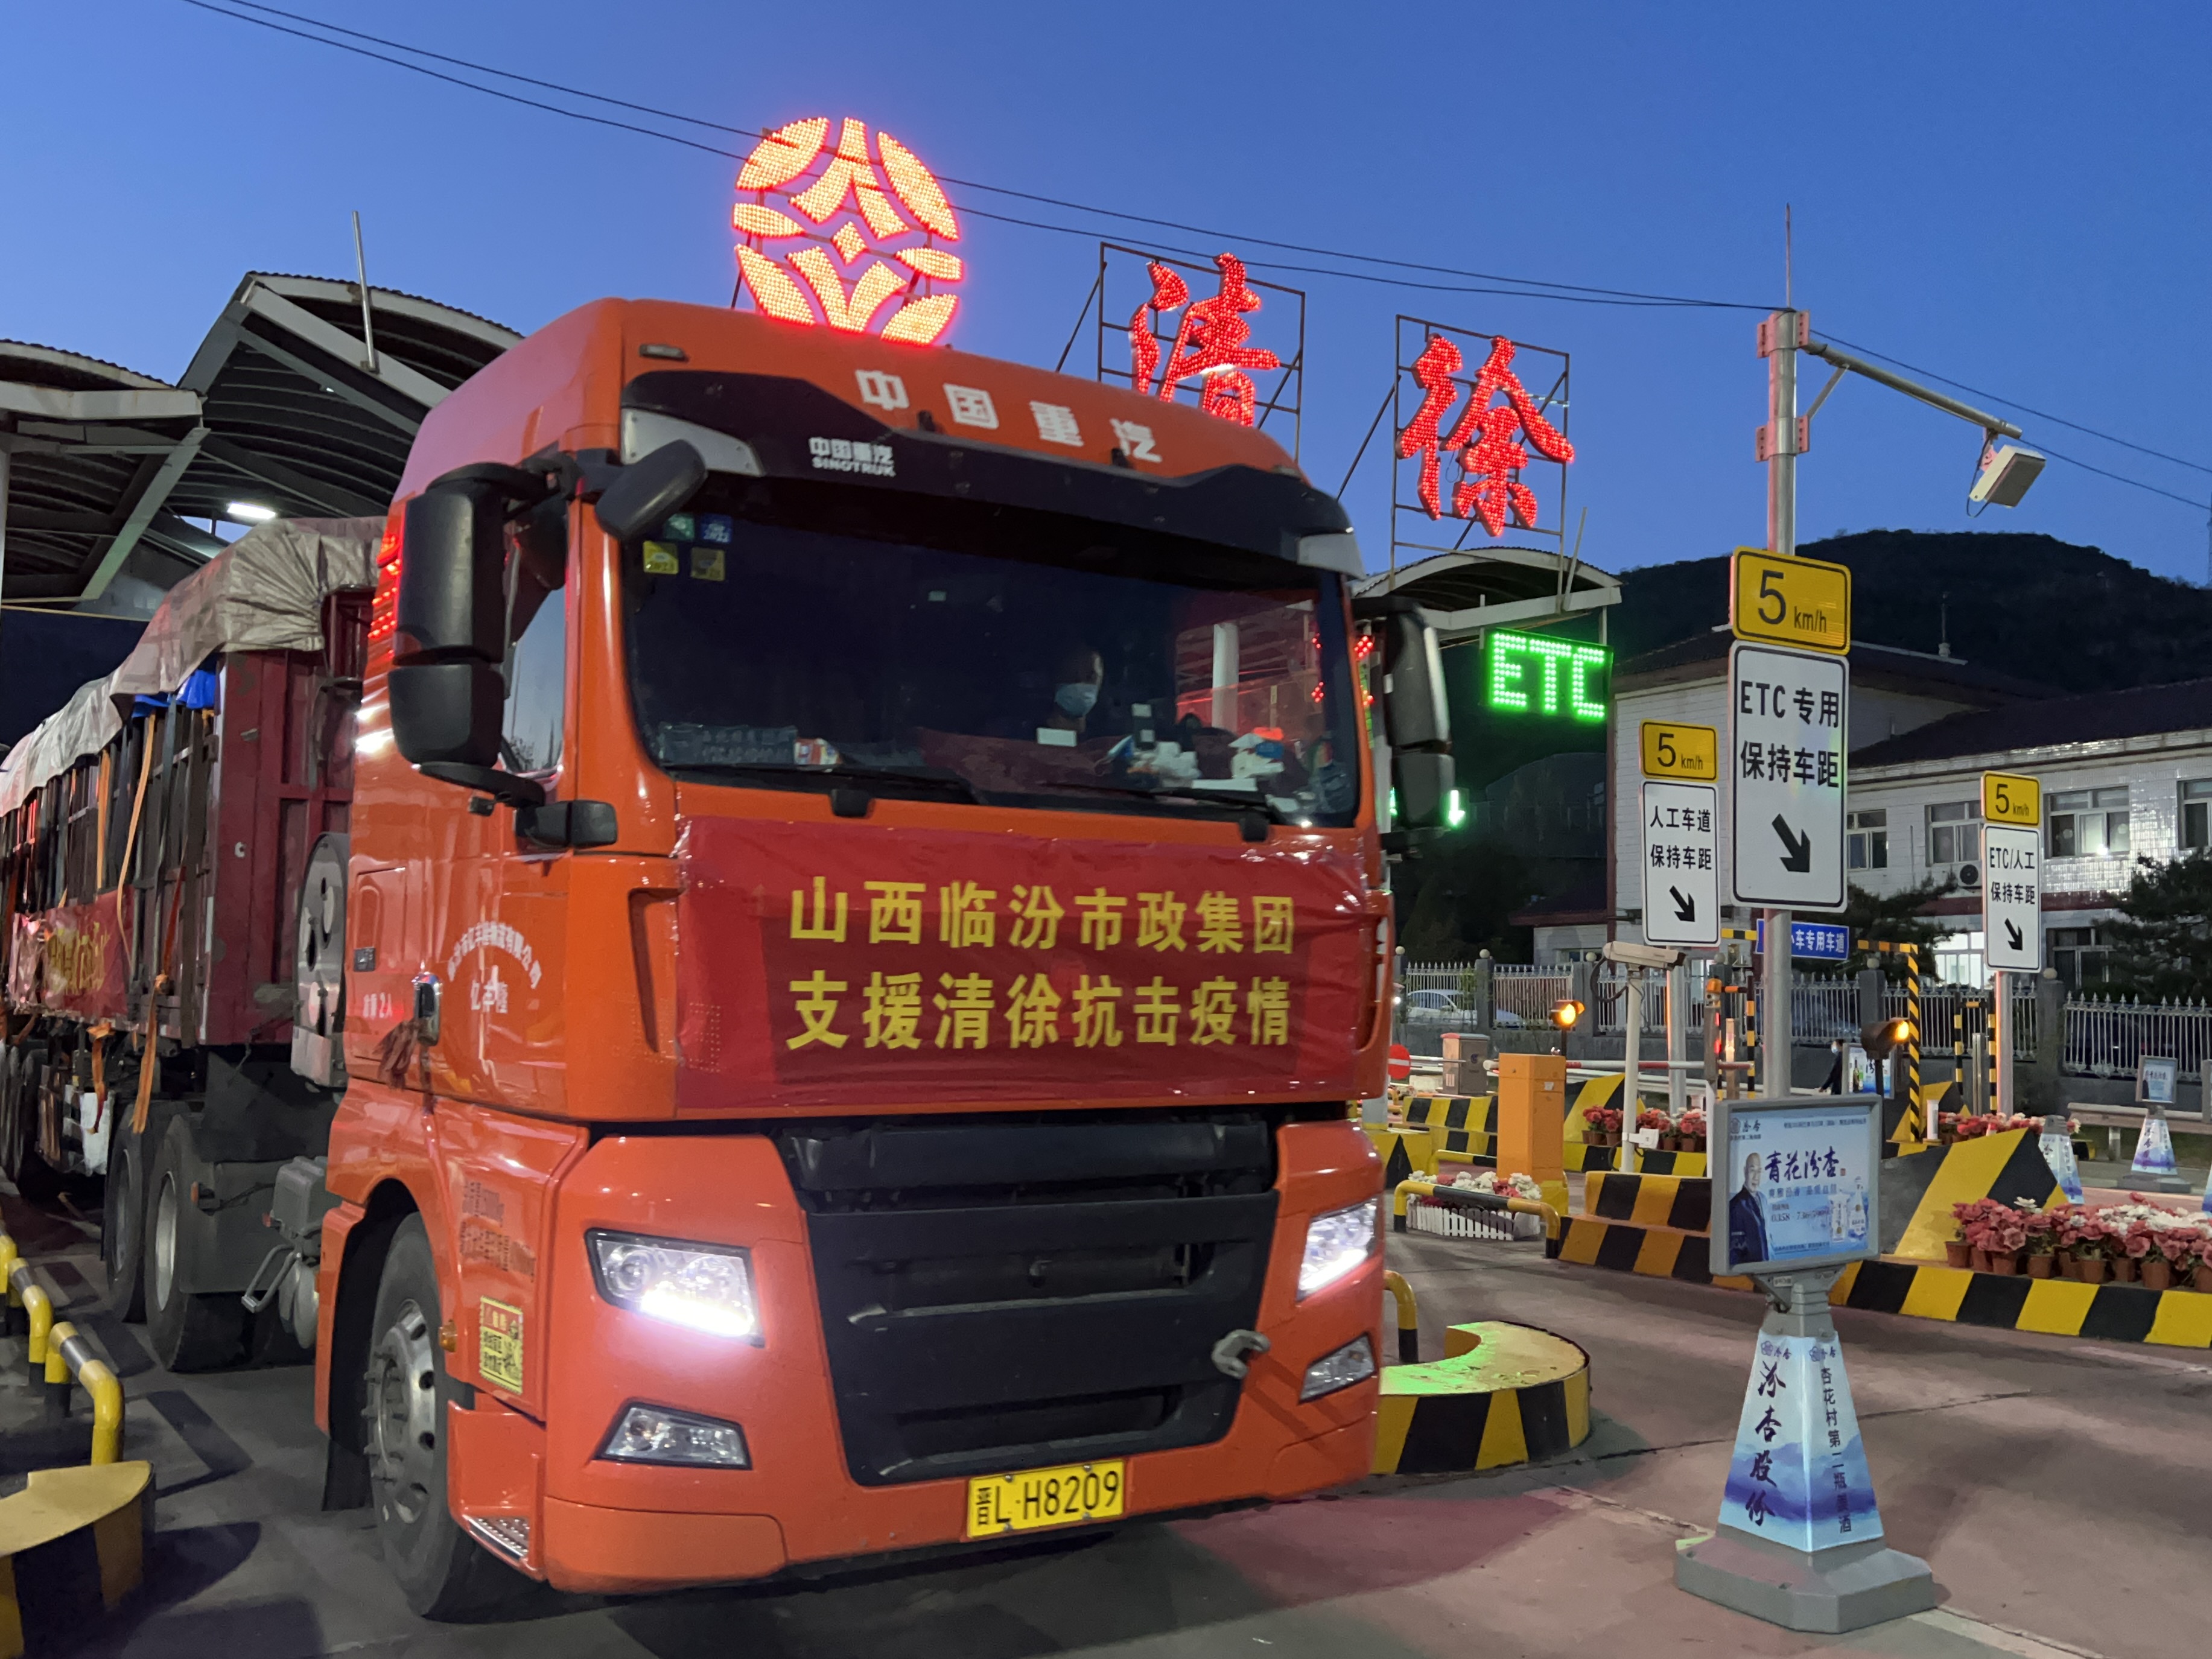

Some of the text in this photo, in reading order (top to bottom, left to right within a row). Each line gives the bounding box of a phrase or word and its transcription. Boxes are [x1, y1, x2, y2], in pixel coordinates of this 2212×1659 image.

[855, 369, 1162, 464] 中国重汽
[1758, 569, 1827, 633] 5 km/h
[1492, 631, 1606, 721] ETC
[1741, 680, 1840, 728] ETC 专用
[1657, 733, 1703, 771] 5 km/h
[1740, 740, 1840, 789] 保持车距
[1650, 805, 1712, 834] 人工车道
[1995, 784, 2030, 817] 5 km/h
[1650, 843, 1712, 871] 保持车距
[1990, 846, 2036, 870] ETC/人工
[789, 875, 1295, 954] 山西临汾市政集团
[1991, 881, 2035, 906] 保持车距
[1791, 929, 1845, 953] 车专用车道
[786, 970, 1291, 1050] 支援清徐抗击疫情
